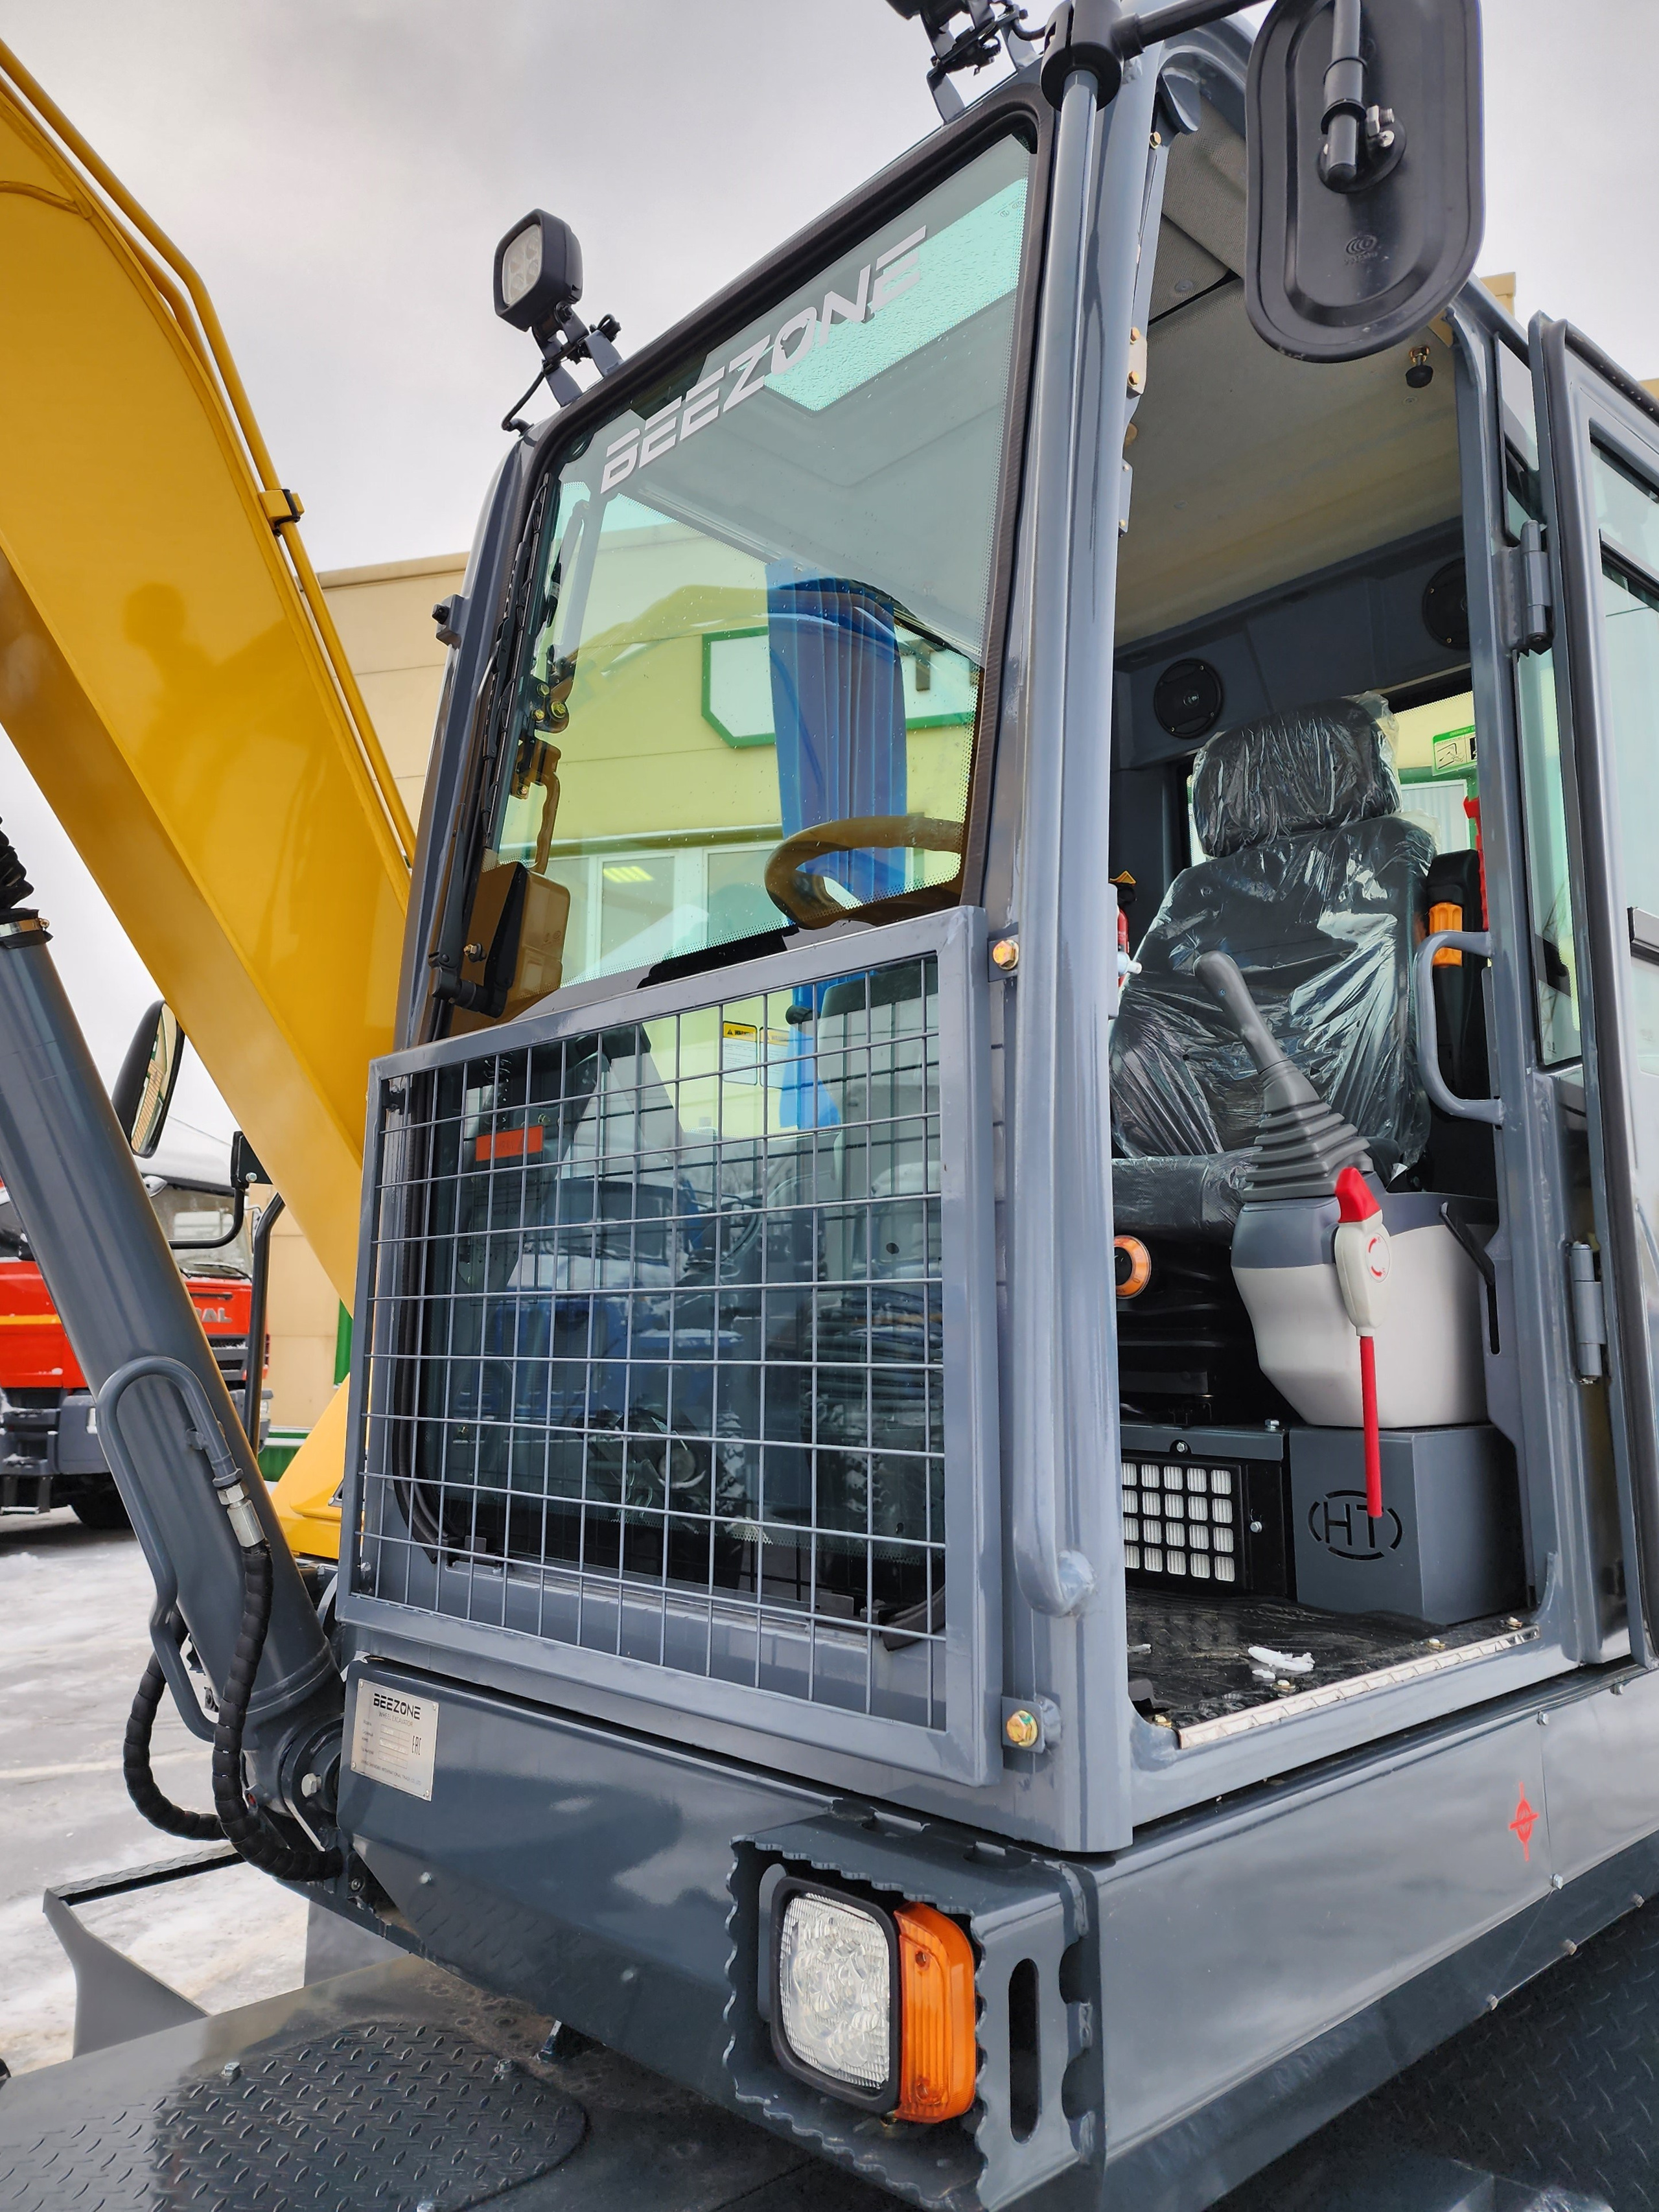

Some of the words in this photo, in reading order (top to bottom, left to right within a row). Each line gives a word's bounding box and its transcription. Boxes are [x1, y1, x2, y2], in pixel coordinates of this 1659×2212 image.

[600, 225, 927, 494] BEEZONE
[1323, 1502, 1384, 1548] HT
[373, 1693, 421, 1720] BEEZONE
[378, 1711, 391, 1721] WHEEL
[391, 1715, 413, 1727] EXCAVATOR
